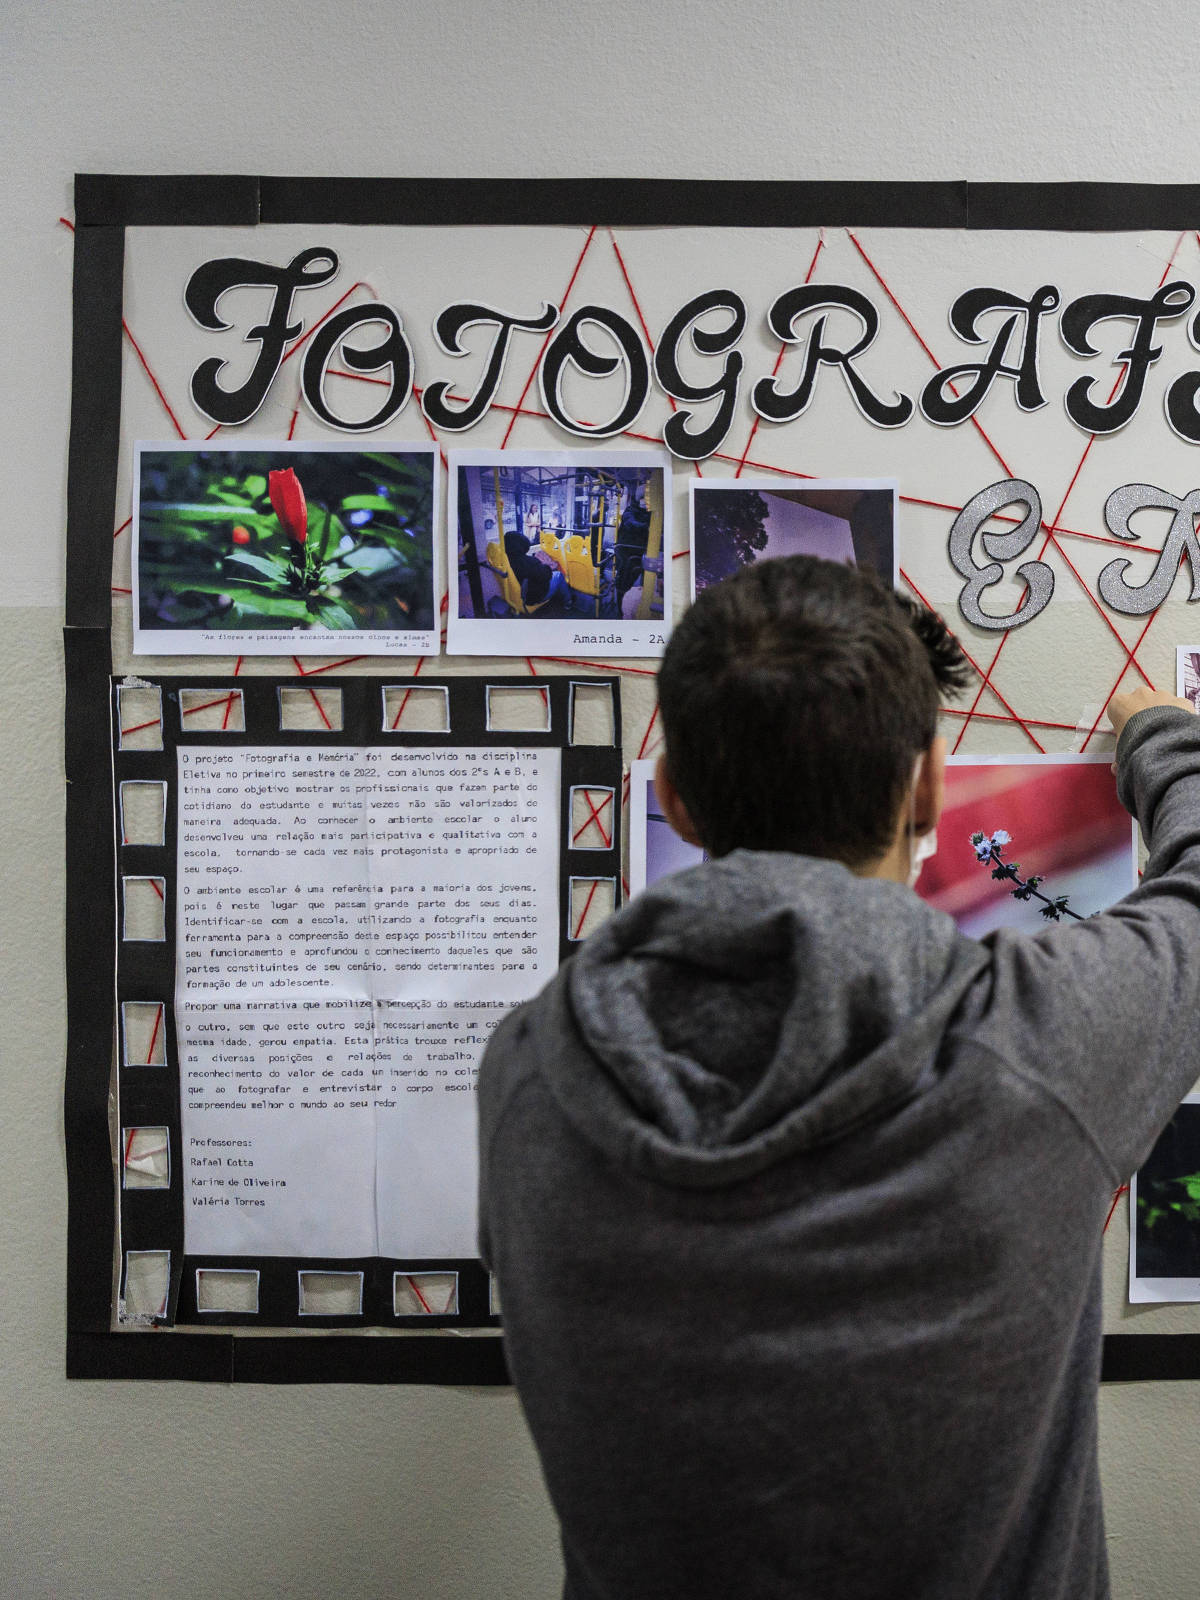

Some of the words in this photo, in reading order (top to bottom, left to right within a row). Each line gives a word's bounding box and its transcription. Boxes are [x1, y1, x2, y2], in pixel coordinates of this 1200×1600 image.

[573, 633, 624, 644] Amanda
[648, 634, 665, 644] 2A
[190, 1157, 222, 1167] Rafael
[226, 1158, 254, 1167] Cotta
[191, 1177, 225, 1186] Karine
[227, 1177, 239, 1187] de
[243, 1178, 287, 1187] Oliveira
[192, 1196, 230, 1206] Valéria
[233, 1196, 266, 1207] Torres
